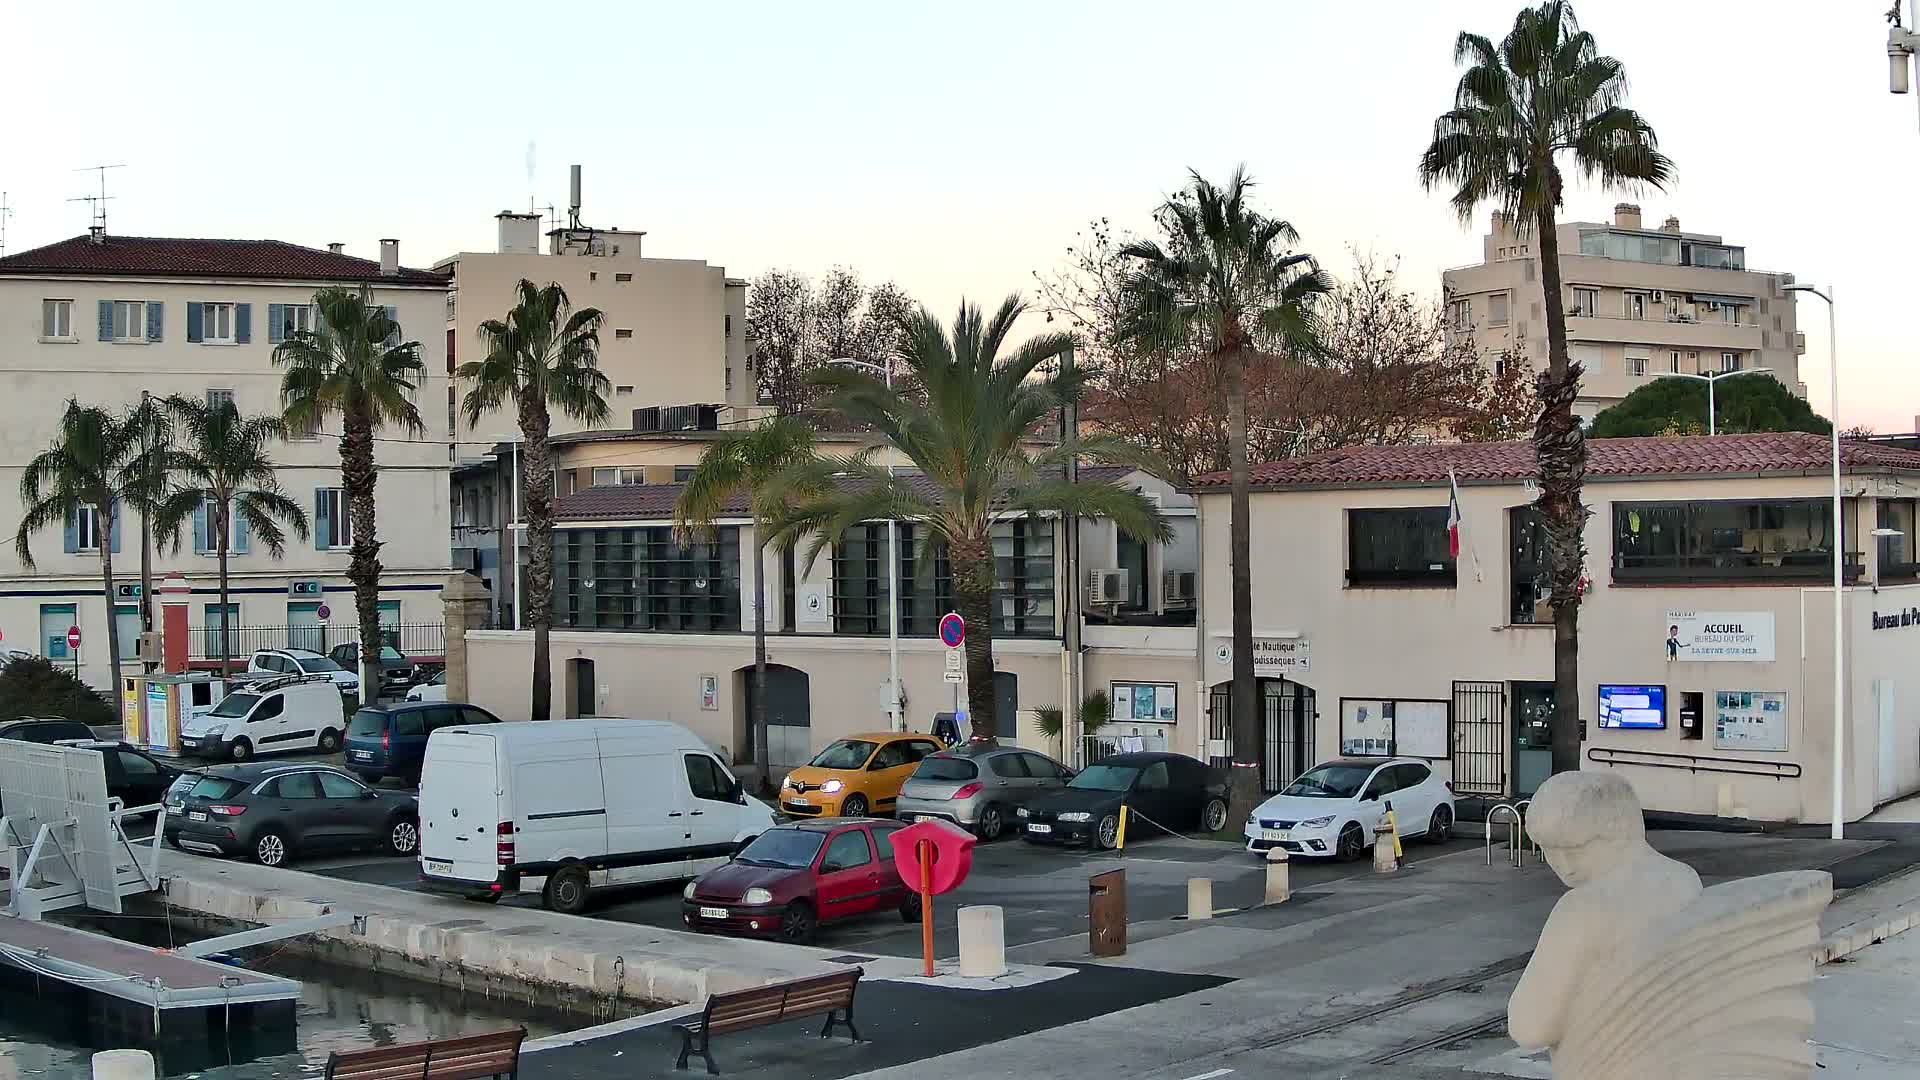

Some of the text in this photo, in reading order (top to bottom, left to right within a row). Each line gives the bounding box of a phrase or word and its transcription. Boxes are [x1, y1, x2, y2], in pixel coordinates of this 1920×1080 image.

[1872, 611, 1900, 630] Bureau
[1901, 607, 1911, 627] du
[1703, 624, 1744, 634] ACCUEIL
[1694, 635, 1753, 643] BUREAU DU PORT
[1262, 641, 1295, 653] Nautique
